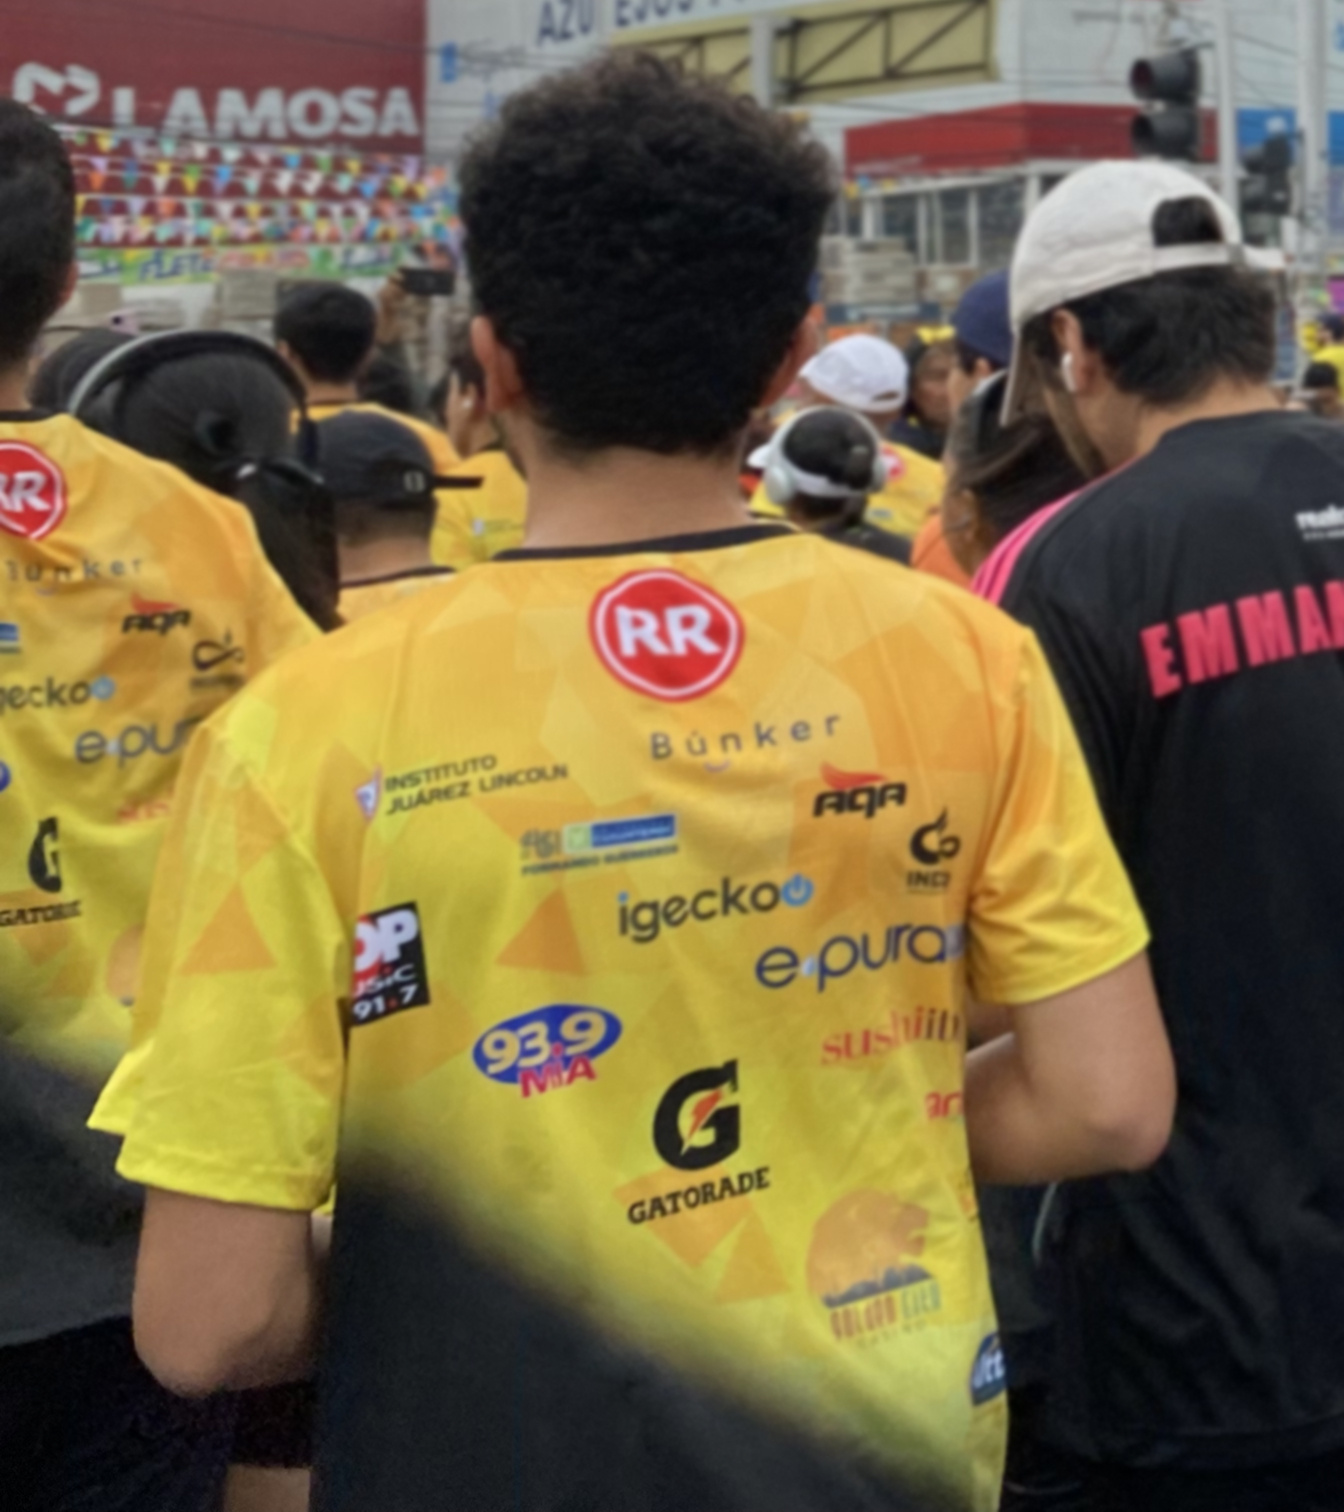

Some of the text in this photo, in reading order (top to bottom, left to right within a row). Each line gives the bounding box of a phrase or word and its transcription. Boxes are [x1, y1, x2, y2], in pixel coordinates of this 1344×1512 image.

[112, 87, 420, 139] LAMOSA
[617, 602, 722, 658] RR
[385, 754, 497, 792] INSTITUTO
[478, 764, 568, 792] LINCOLN
[617, 876, 780, 944] igecko
[354, 908, 419, 972] OP
[481, 1010, 608, 1076] 93.9
[627, 1166, 771, 1226] GATORADE
